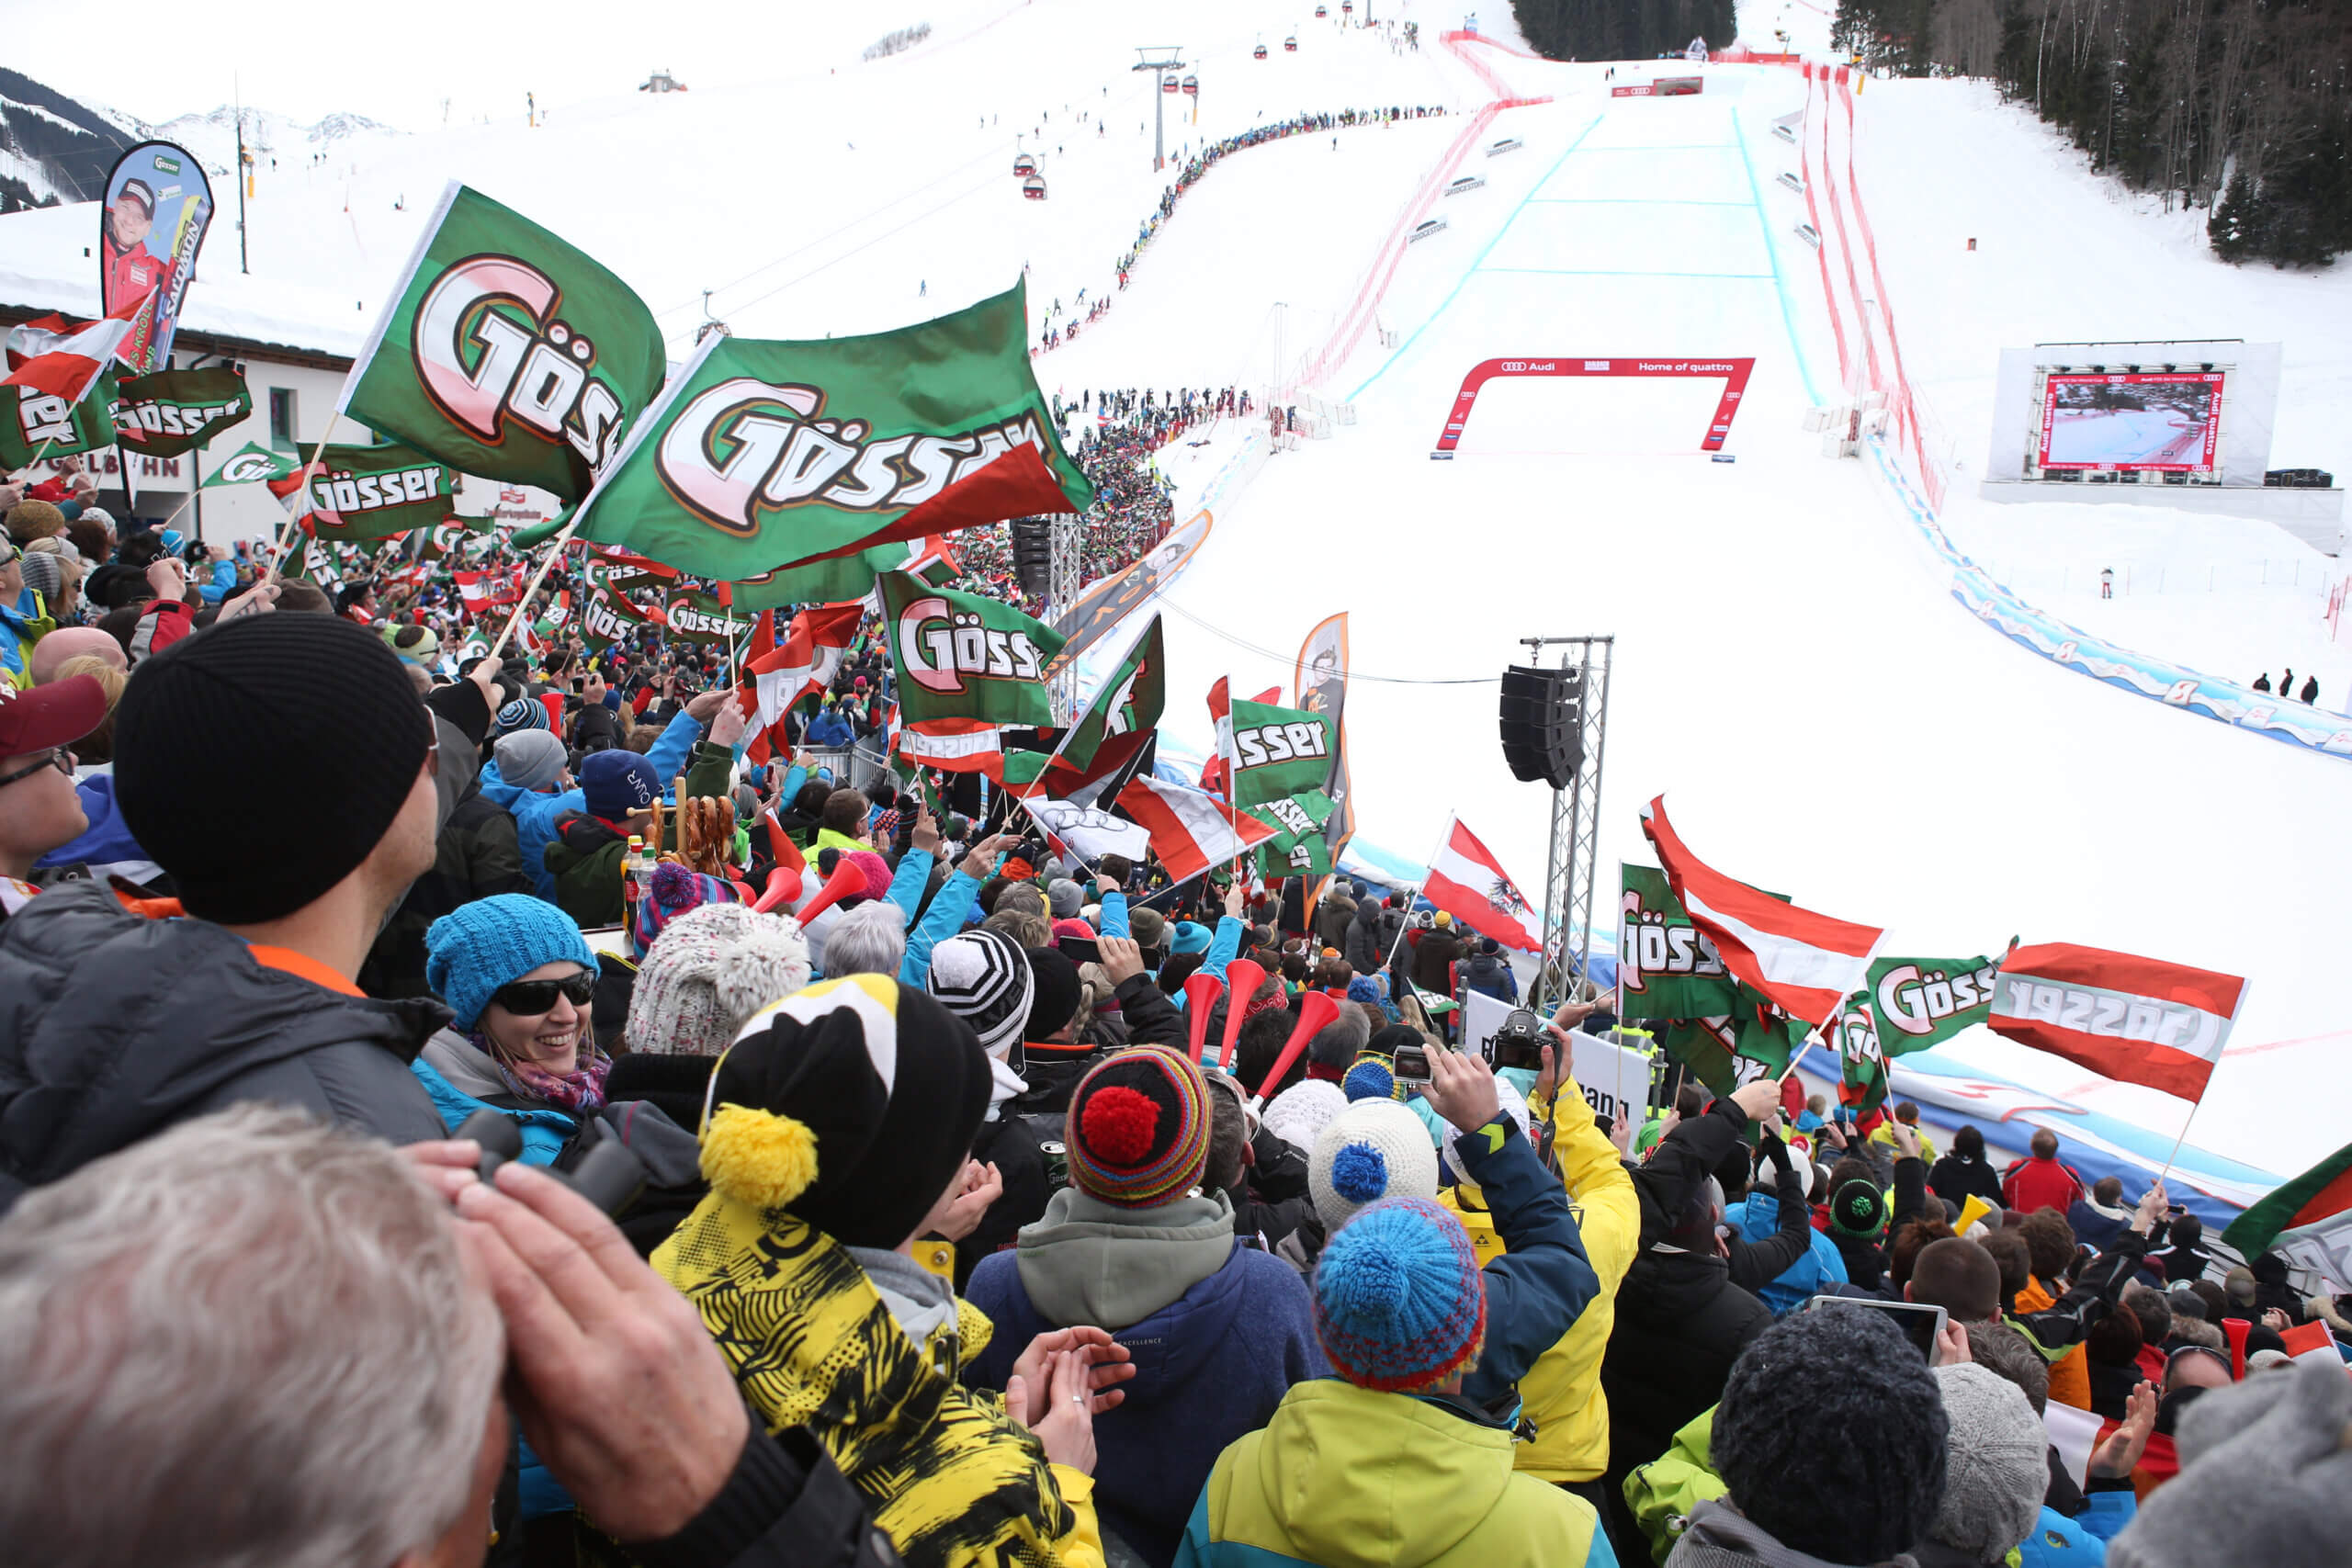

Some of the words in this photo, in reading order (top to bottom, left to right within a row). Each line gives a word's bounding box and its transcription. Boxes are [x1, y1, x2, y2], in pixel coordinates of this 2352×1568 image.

[1529, 362, 1555, 371] Audi
[1639, 362, 1672, 371] Home
[1675, 362, 1689, 371] of
[1690, 362, 1734, 374] quattro
[2042, 392, 2054, 429] quattro
[2211, 391, 2222, 416] Audi
[2041, 430, 2050, 453] Audi
[2205, 417, 2217, 455] quattro
[303, 461, 442, 526] Gösser
